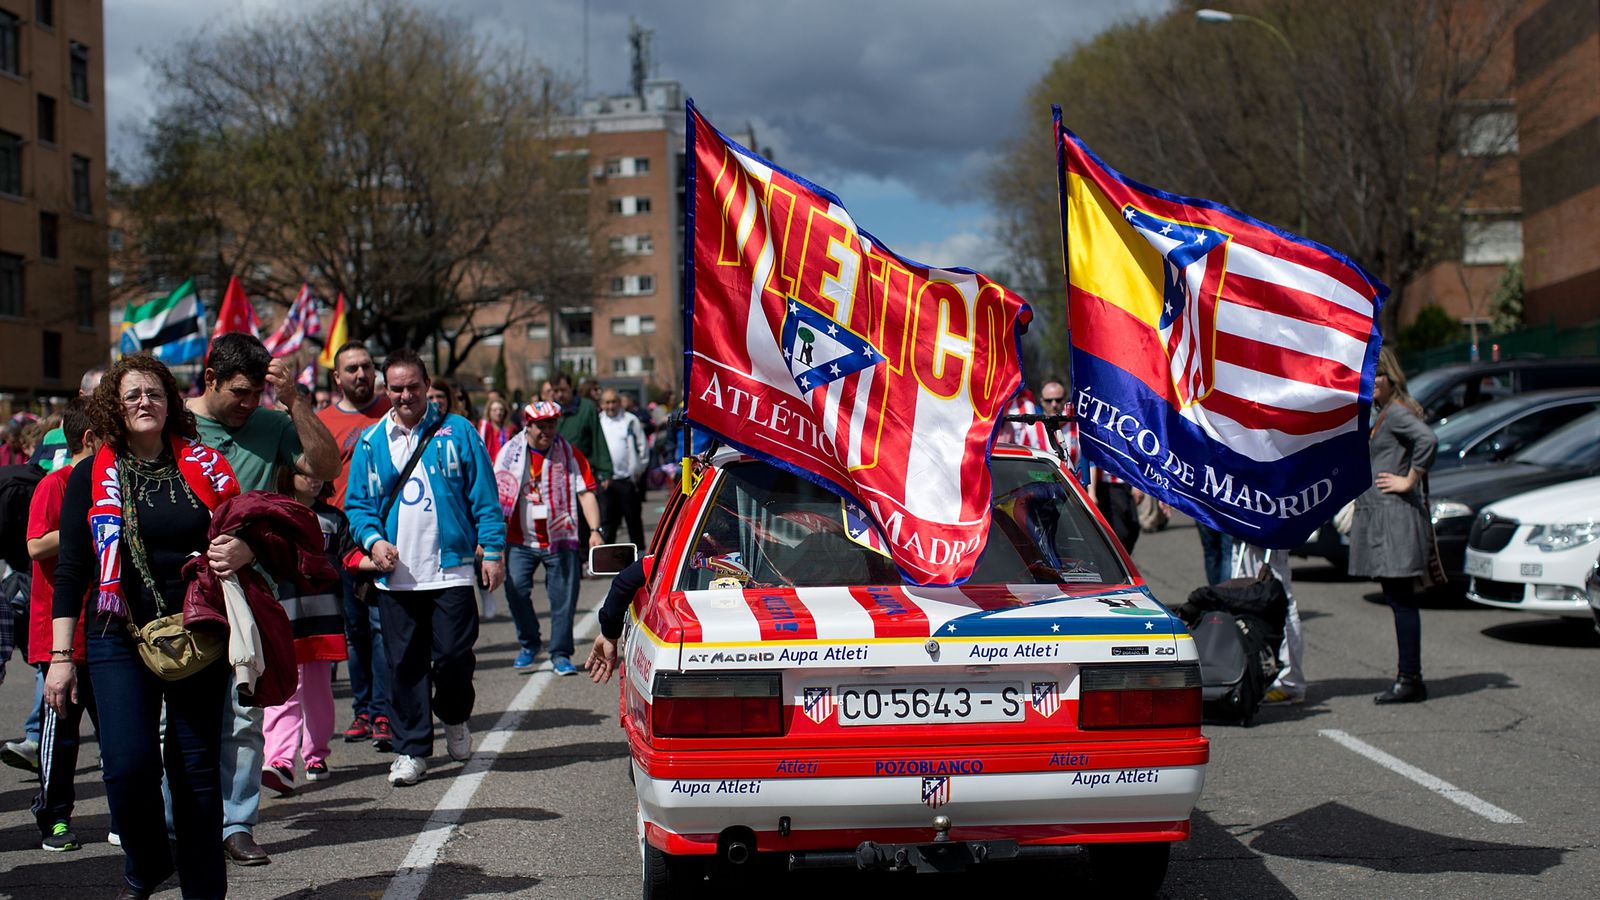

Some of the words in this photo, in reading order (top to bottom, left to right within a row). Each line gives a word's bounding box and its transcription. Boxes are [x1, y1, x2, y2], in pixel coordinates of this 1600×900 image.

[1076, 387, 1160, 456] ÉTICO
[1162, 450, 1195, 487] DE
[1201, 464, 1333, 519] MADRID
[700, 371, 837, 458] ATLÉTIC
[869, 500, 981, 566] MADRD
[688, 654, 709, 663] AT
[711, 652, 775, 664] MADRID
[779, 648, 818, 665] Aupa
[824, 645, 868, 661] Atleti
[969, 645, 1009, 661] Aupa
[1013, 643, 1059, 658] Atleti
[776, 759, 819, 774] Atleti
[875, 760, 984, 775] POZOBLANCO
[1049, 752, 1090, 767] Atleti
[1072, 771, 1111, 788] Aupa
[1116, 769, 1159, 784] Atleti
[671, 780, 711, 797] Aupa
[716, 780, 762, 794] Atleti
